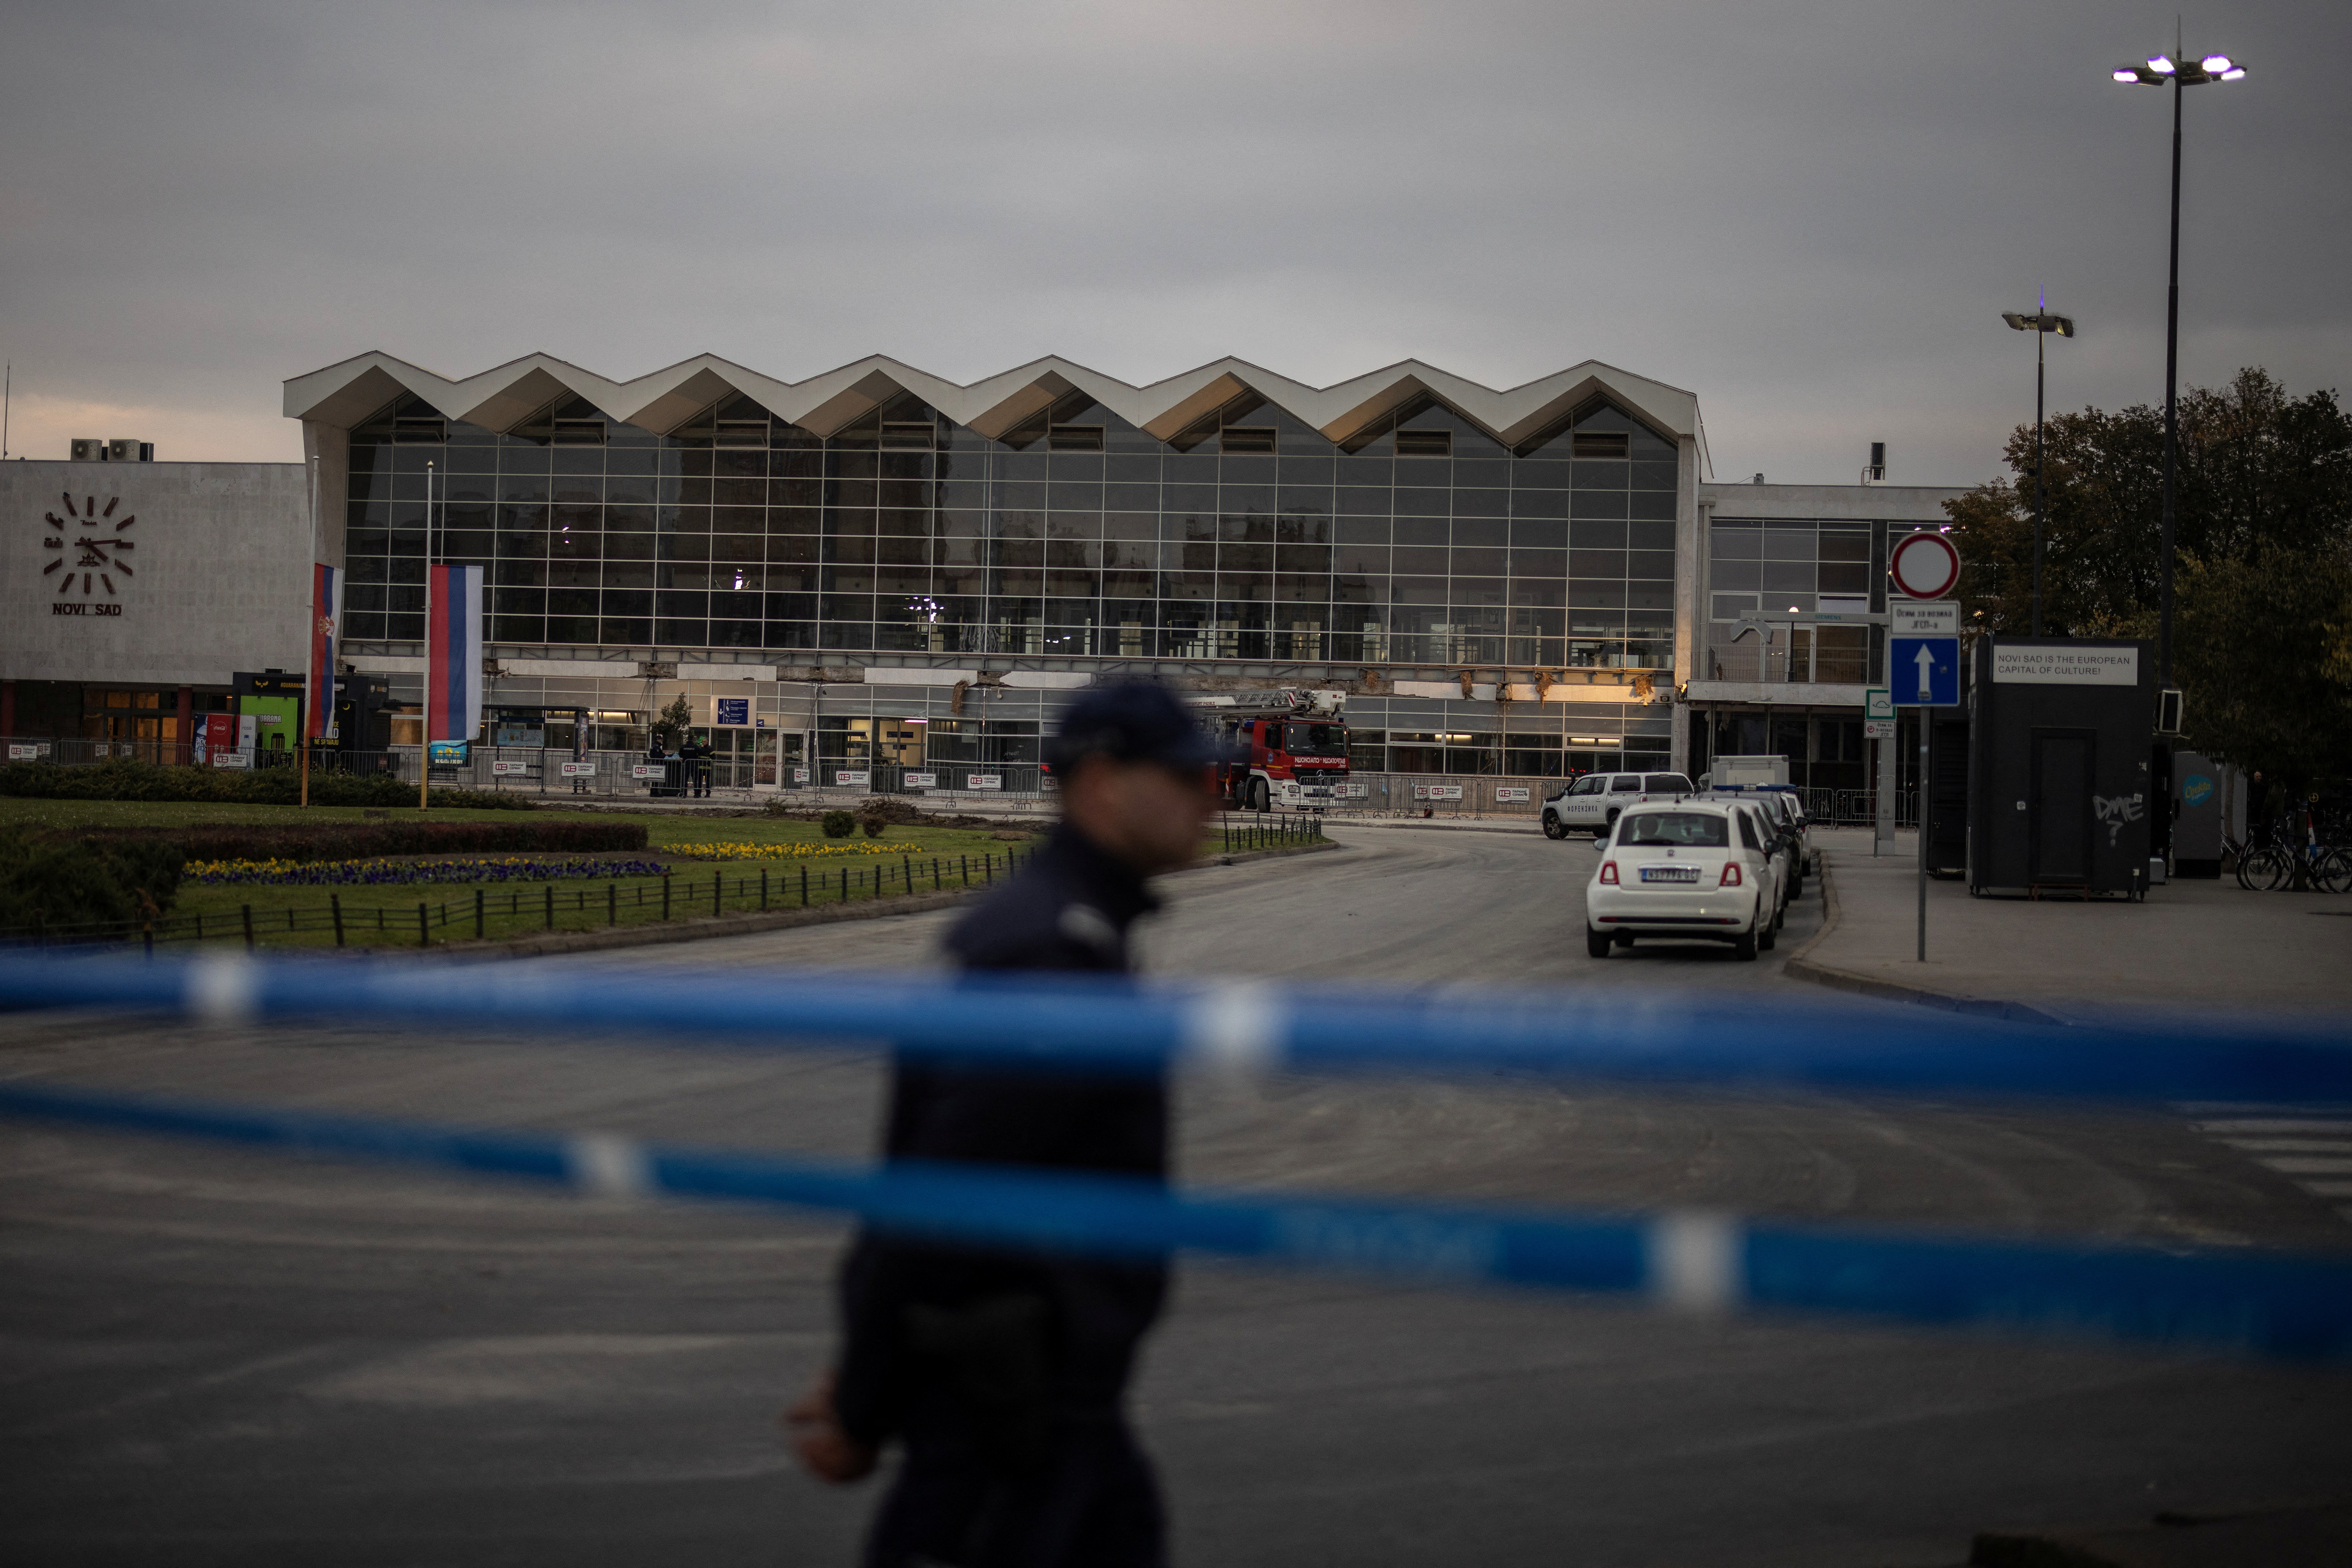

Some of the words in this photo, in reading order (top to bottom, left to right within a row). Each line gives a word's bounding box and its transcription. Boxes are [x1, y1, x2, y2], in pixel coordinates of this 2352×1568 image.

[53, 603, 85, 615] NOVI
[95, 604, 122, 616] SAD
[259, 715, 281, 723] UARANA
